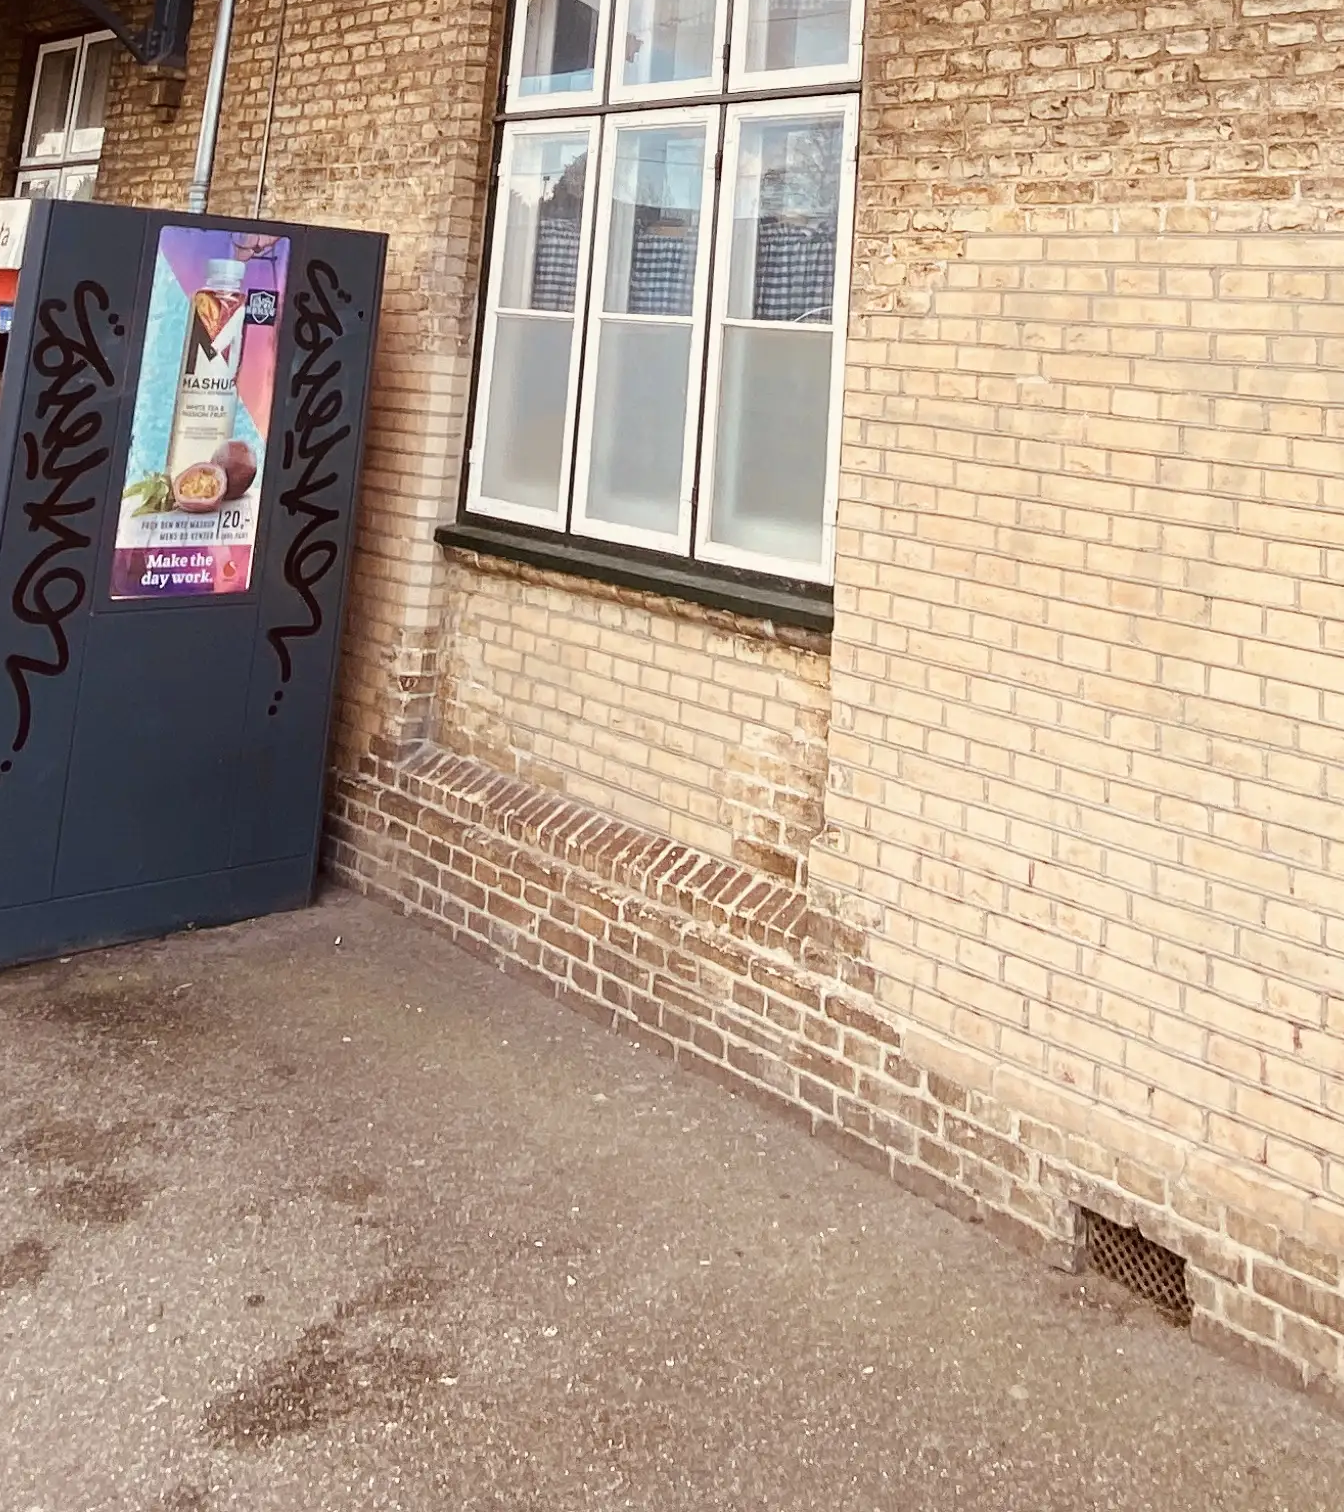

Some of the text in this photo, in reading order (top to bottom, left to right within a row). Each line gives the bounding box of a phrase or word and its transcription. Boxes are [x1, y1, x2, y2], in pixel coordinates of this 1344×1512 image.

[182, 377, 237, 390] MASHUP
[222, 510, 250, 530] 20,-
[147, 553, 213, 568] Make the
[141, 570, 213, 588] day work.
